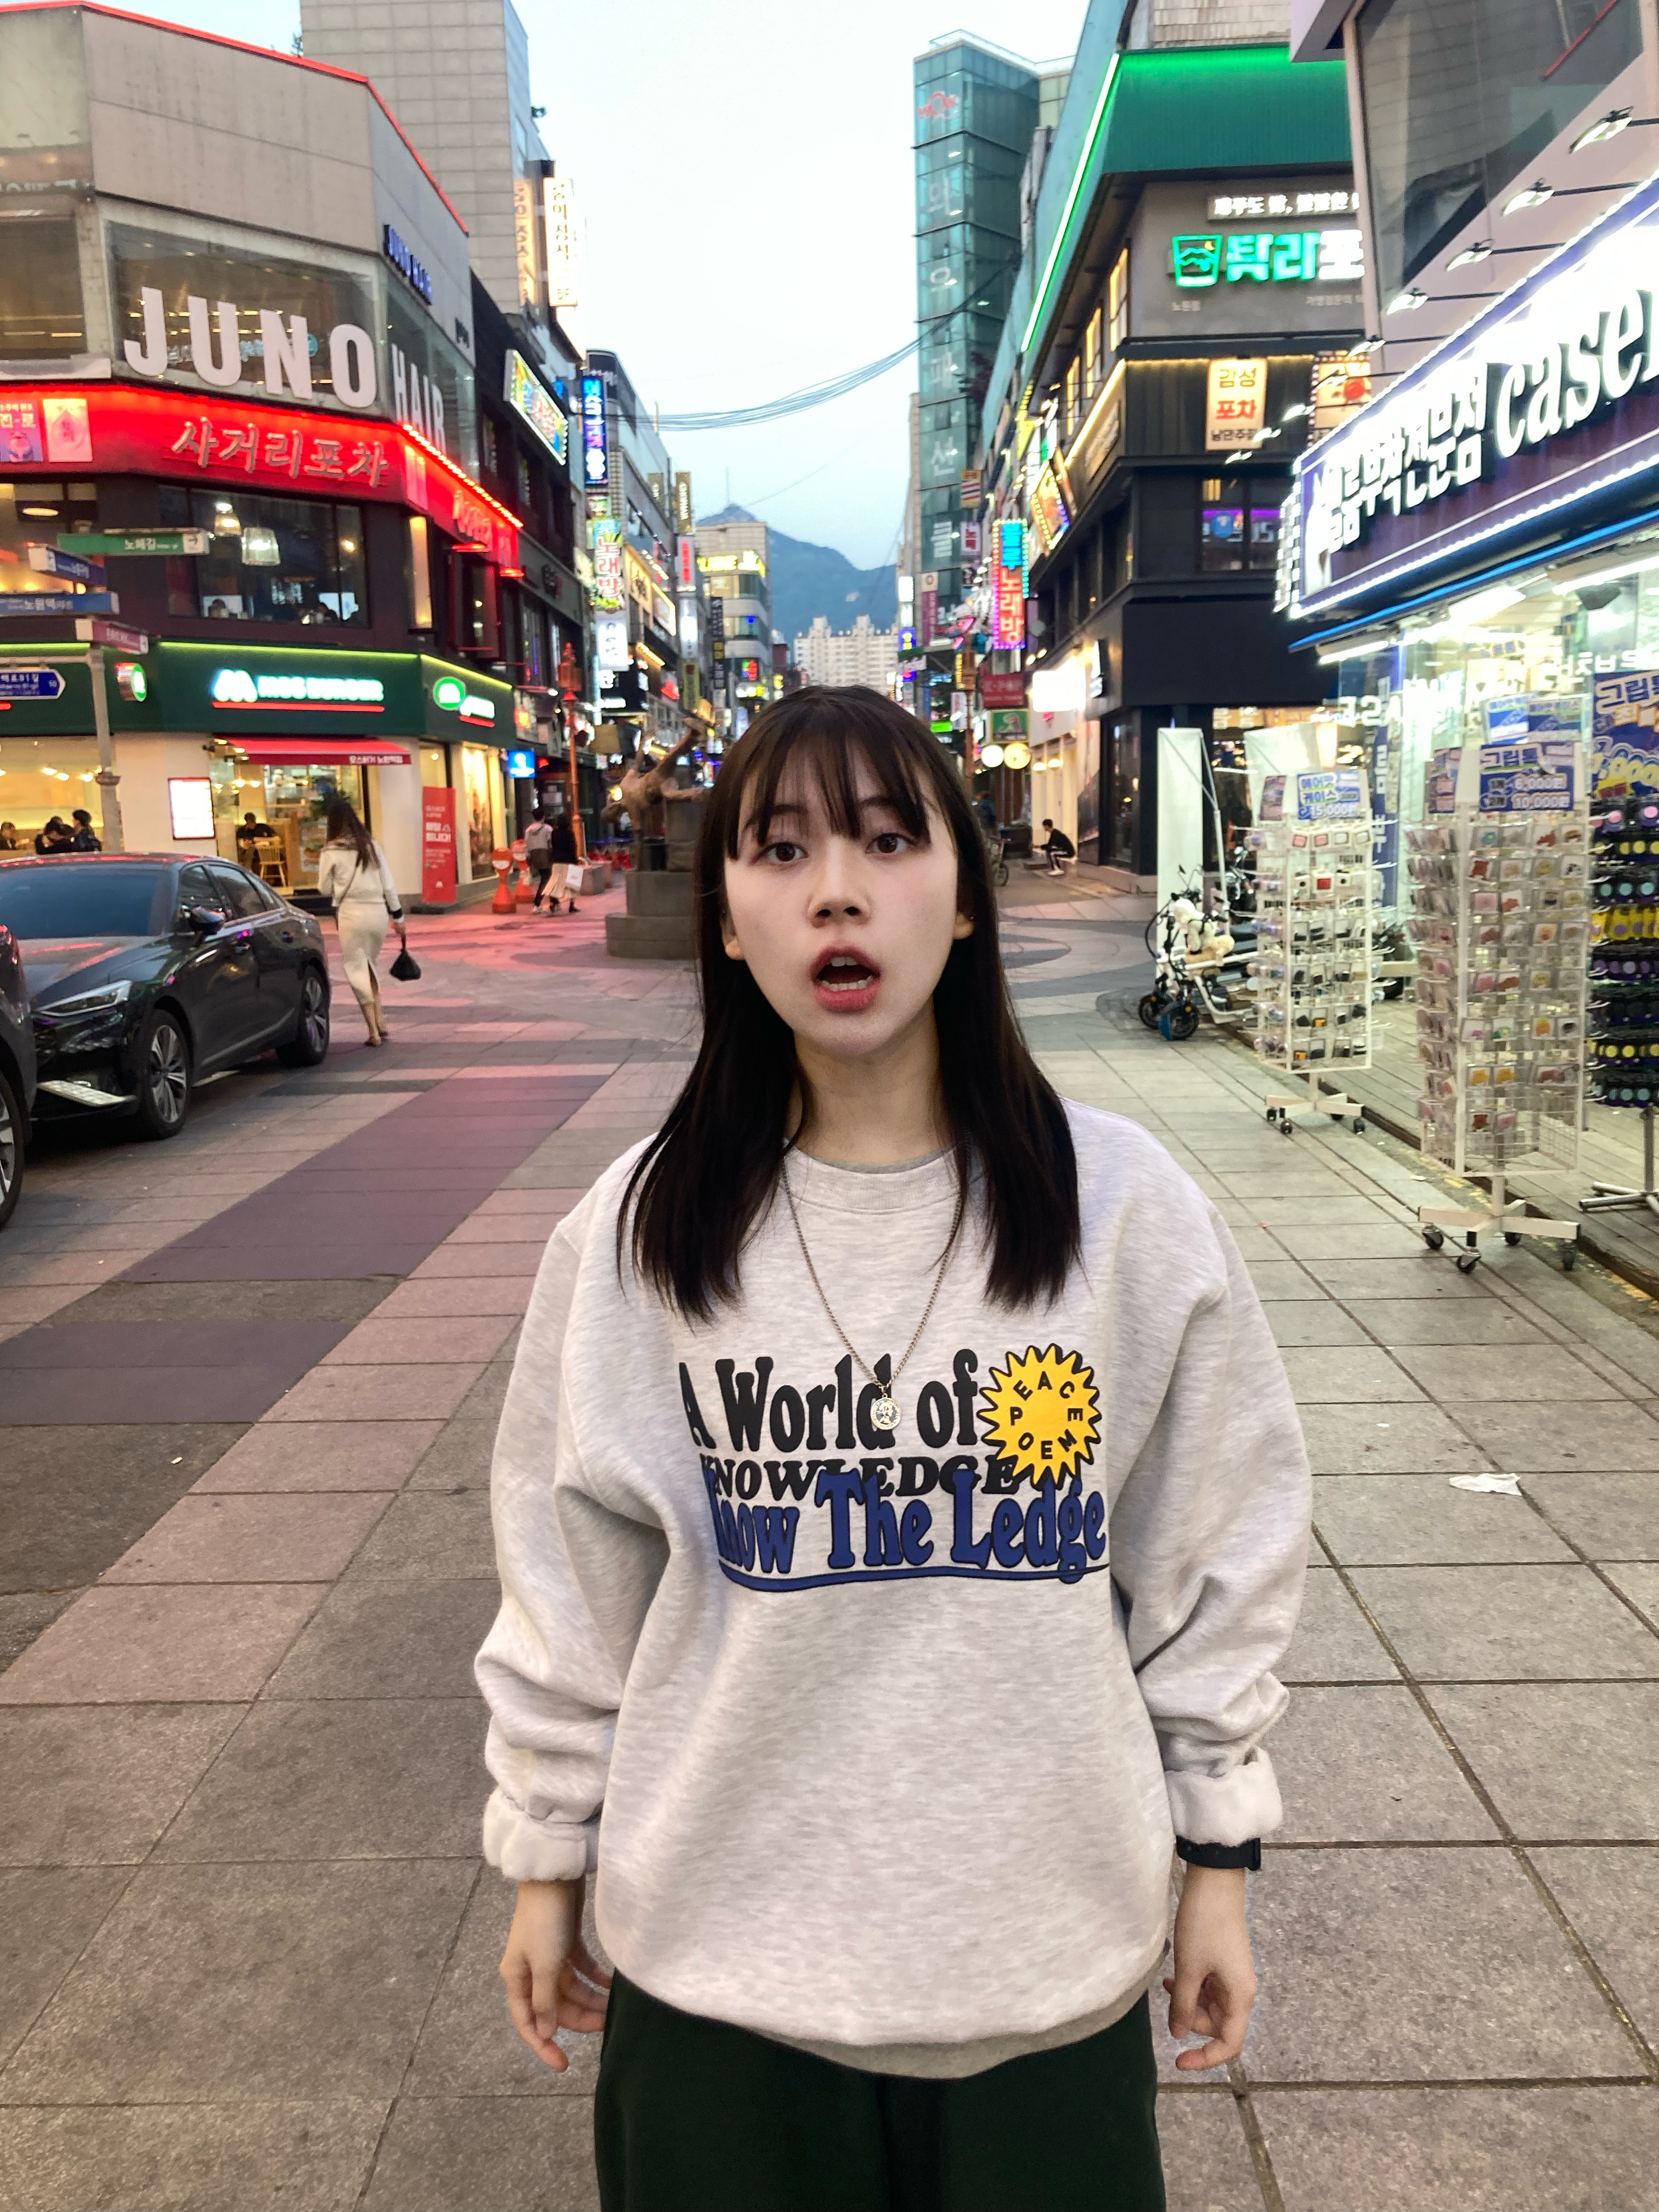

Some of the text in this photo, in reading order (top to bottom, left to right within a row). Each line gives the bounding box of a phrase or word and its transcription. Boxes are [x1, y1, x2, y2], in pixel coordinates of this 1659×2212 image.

[123, 286, 379, 408] JUNO
[391, 343, 448, 455] HAIR
[1218, 368, 1257, 388] 감성
[1496, 285, 1659, 459] case
[1216, 399, 1257, 420] 포차
[171, 416, 389, 488] 사거리포차
[597, 535, 622, 599] 노래방
[999, 567, 1025, 645] 노래방
[715, 1353, 895, 1453] World
[917, 1349, 979, 1449] of
[700, 1453, 1020, 1502] NOWEDGE
[815, 1468, 934, 1568] The
[950, 1466, 1106, 1584] Ledge
